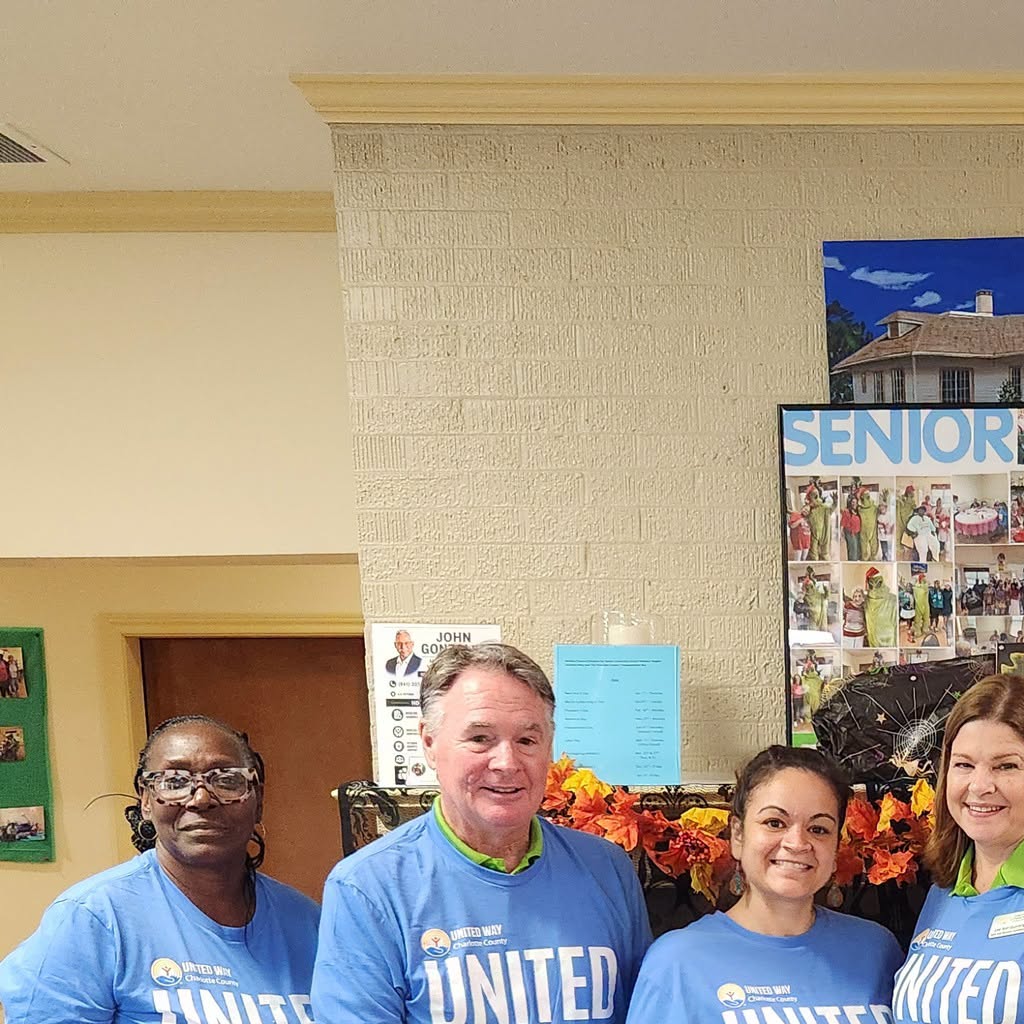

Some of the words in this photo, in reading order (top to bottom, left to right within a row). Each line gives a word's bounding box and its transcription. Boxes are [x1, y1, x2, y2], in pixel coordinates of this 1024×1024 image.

[784, 408, 1014, 466] SENIOR
[436, 632, 471, 642] JOHN
[451, 926, 482, 940] UNITED
[481, 924, 502, 937] WAY
[483, 938, 508, 946] County
[744, 984, 774, 996] UNITED
[773, 984, 791, 995] WAY
